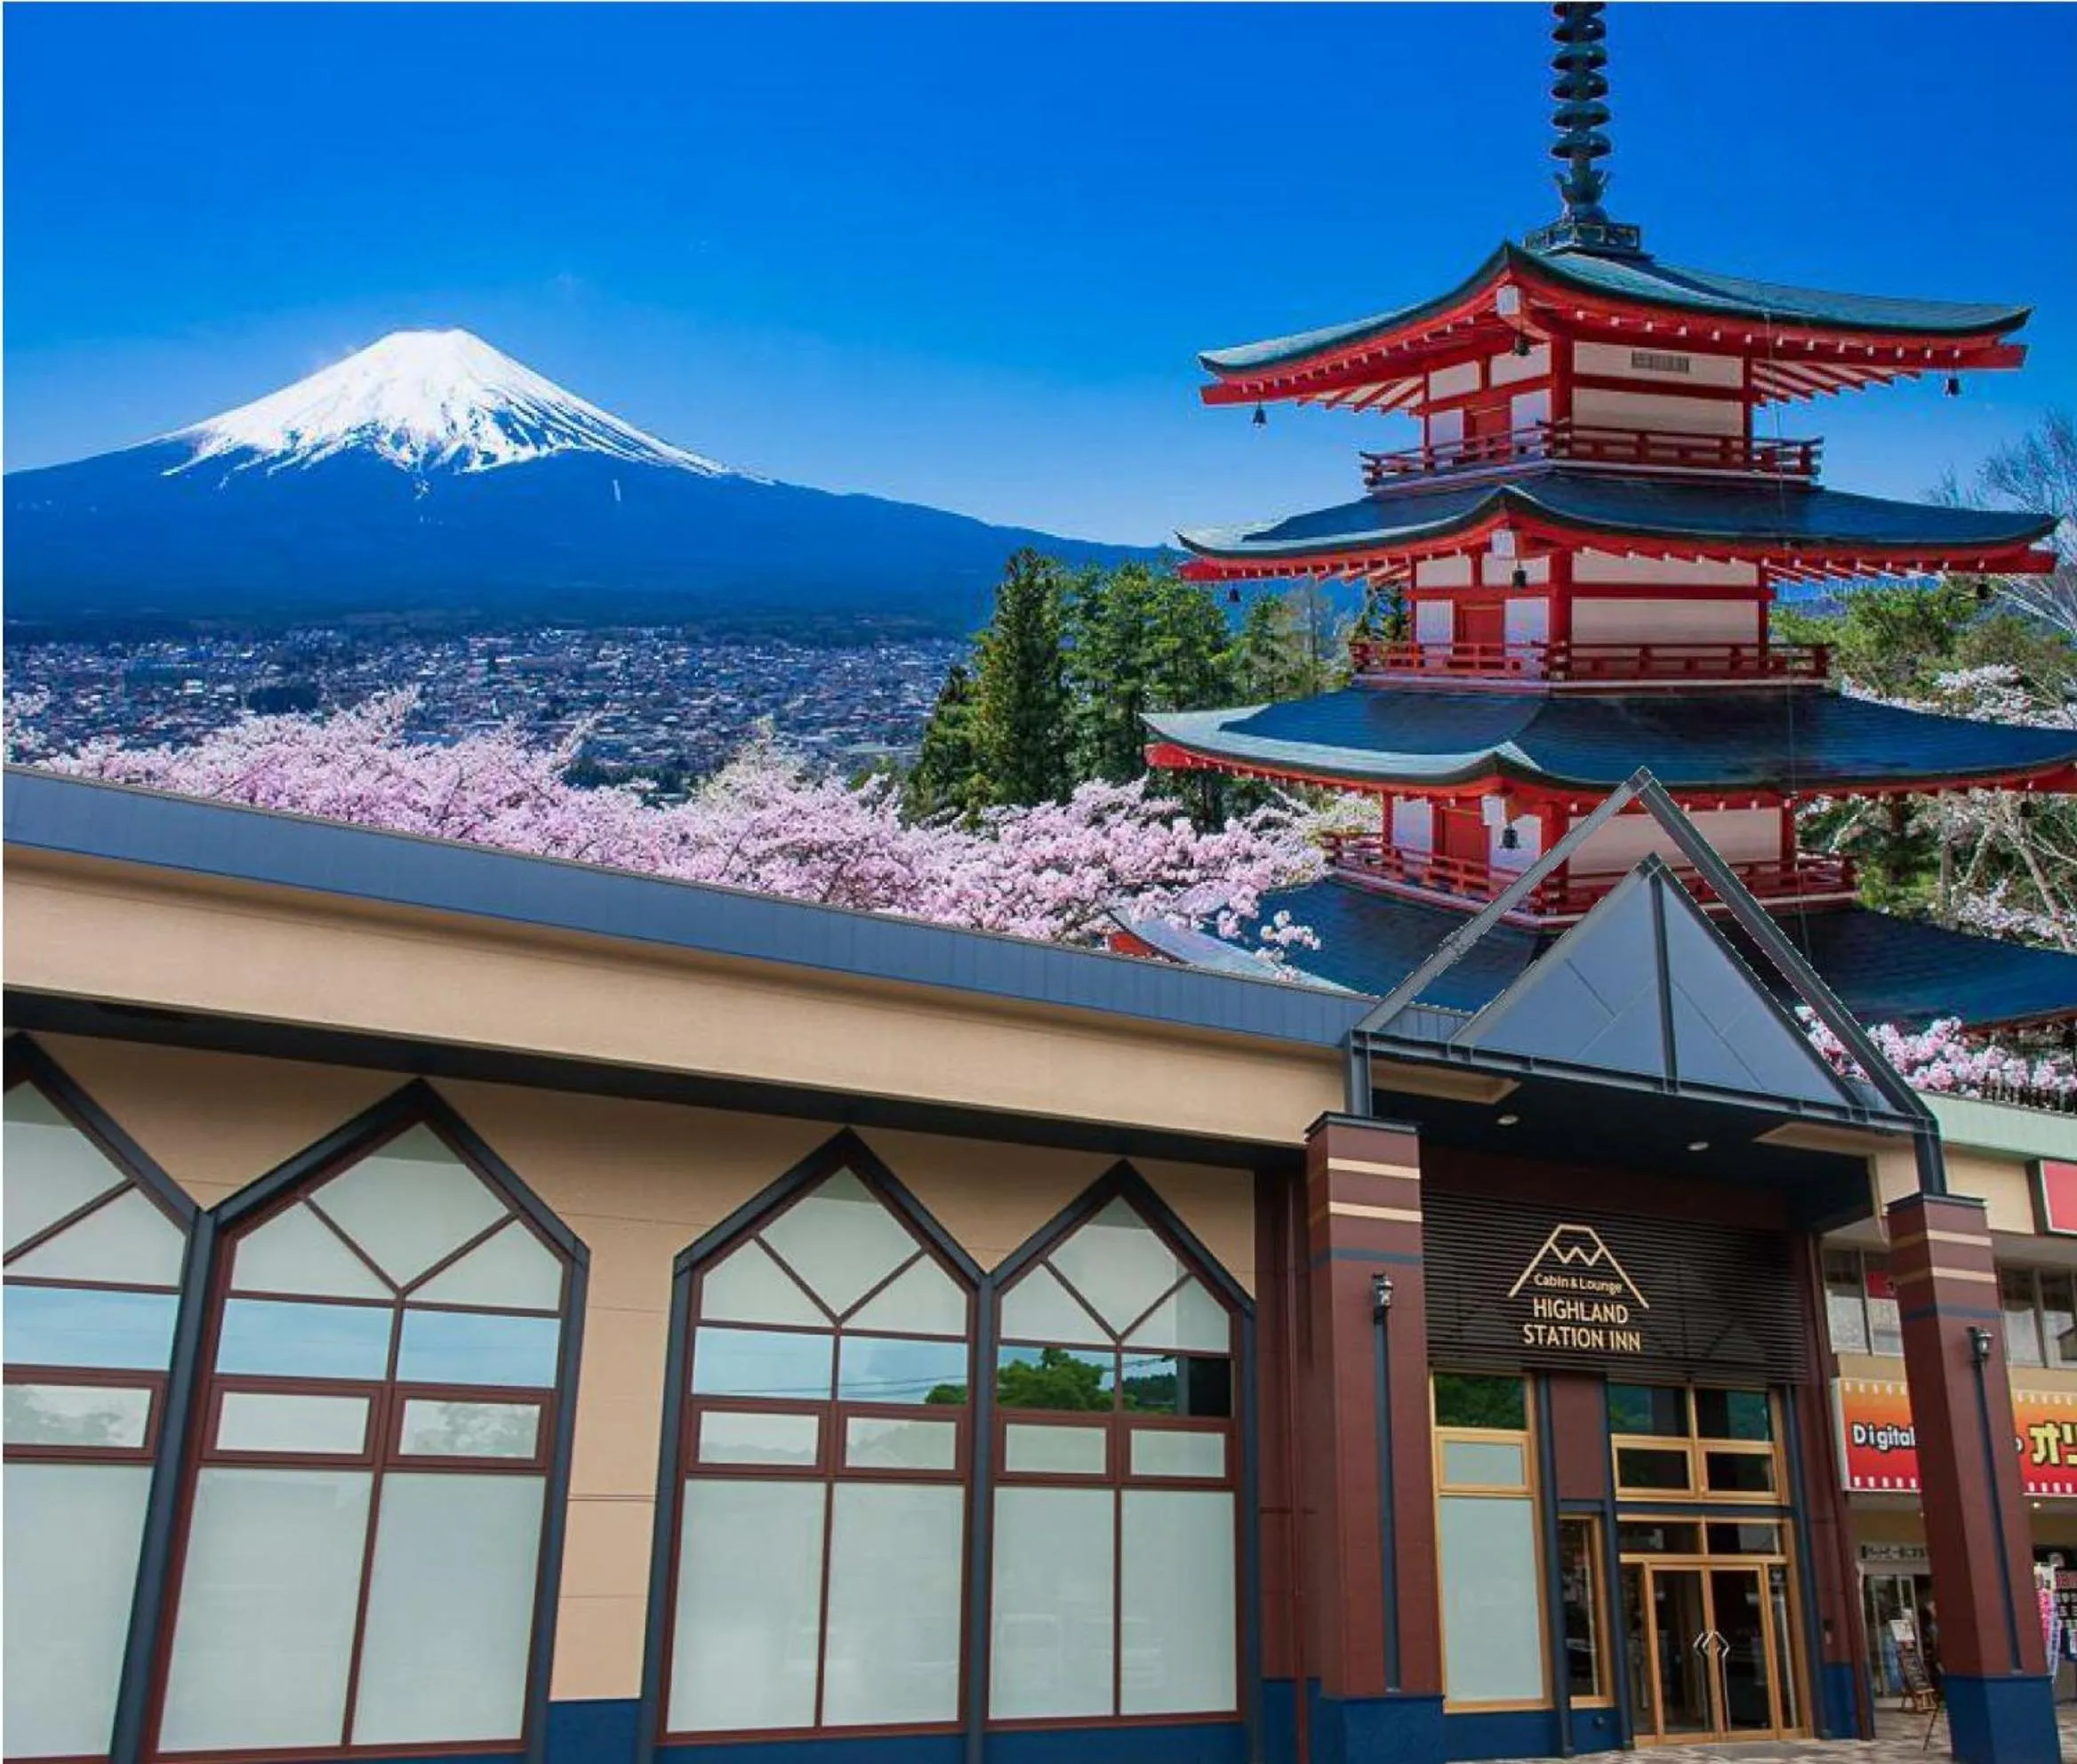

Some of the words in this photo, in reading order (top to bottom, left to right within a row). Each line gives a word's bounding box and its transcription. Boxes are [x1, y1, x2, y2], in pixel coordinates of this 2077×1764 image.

[1534, 1272, 1569, 1288] Cabin
[1570, 1278, 1578, 1288] &
[1580, 1277, 1623, 1295] Lounge
[1533, 1297, 1629, 1324] HIGHLAND
[1523, 1324, 1604, 1347] STATION
[1609, 1330, 1640, 1351] INN
[1853, 1423, 1916, 1451] Digital
